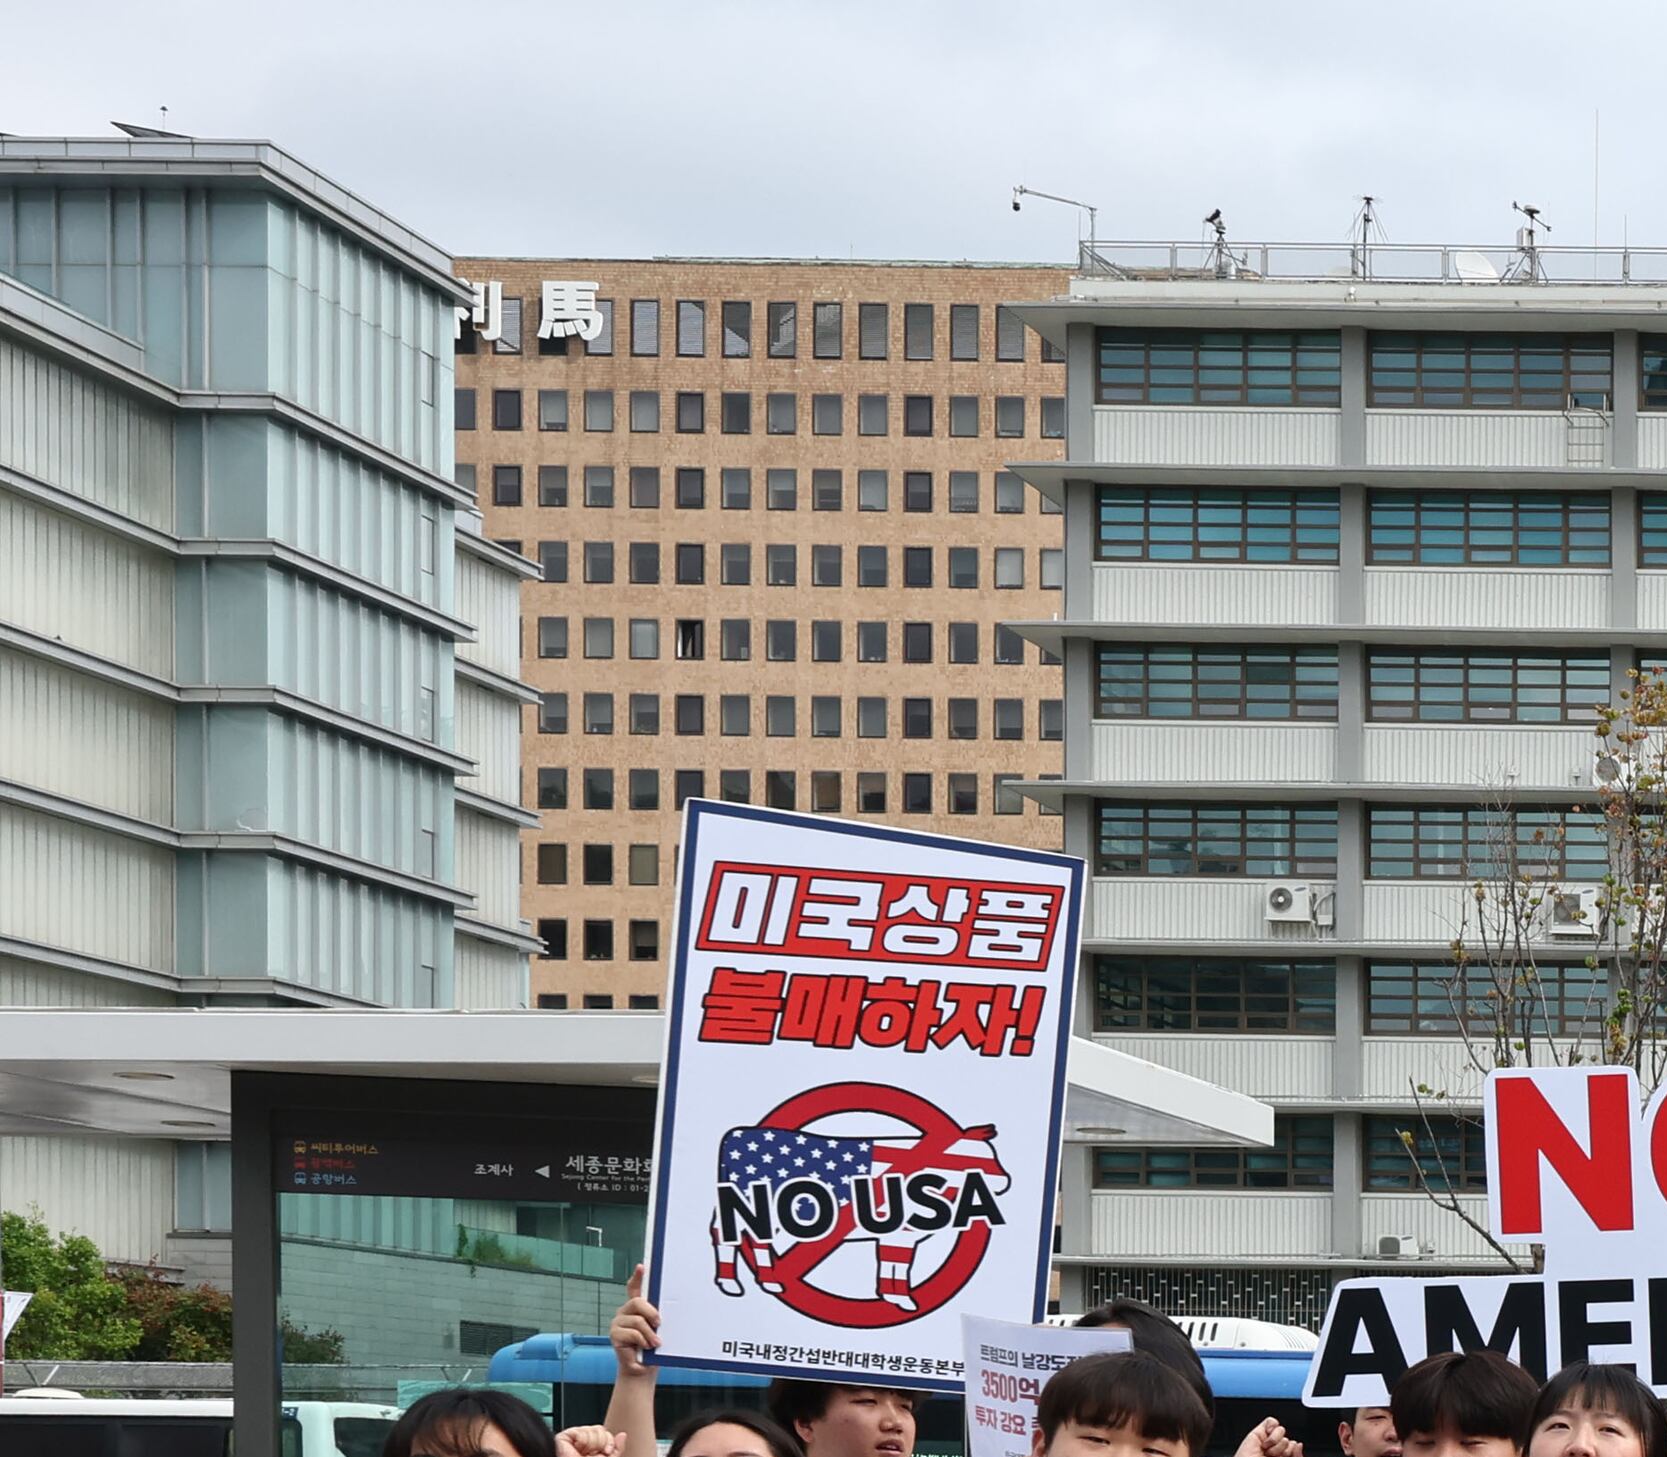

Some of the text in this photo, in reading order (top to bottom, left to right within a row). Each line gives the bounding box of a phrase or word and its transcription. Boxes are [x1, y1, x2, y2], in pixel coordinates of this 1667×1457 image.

[707, 869, 1054, 963] 미국상품
[698, 968, 1046, 1057] 불매하자!
[474, 1164, 513, 1176] 조계사
[718, 1172, 1004, 1243] NO USA
